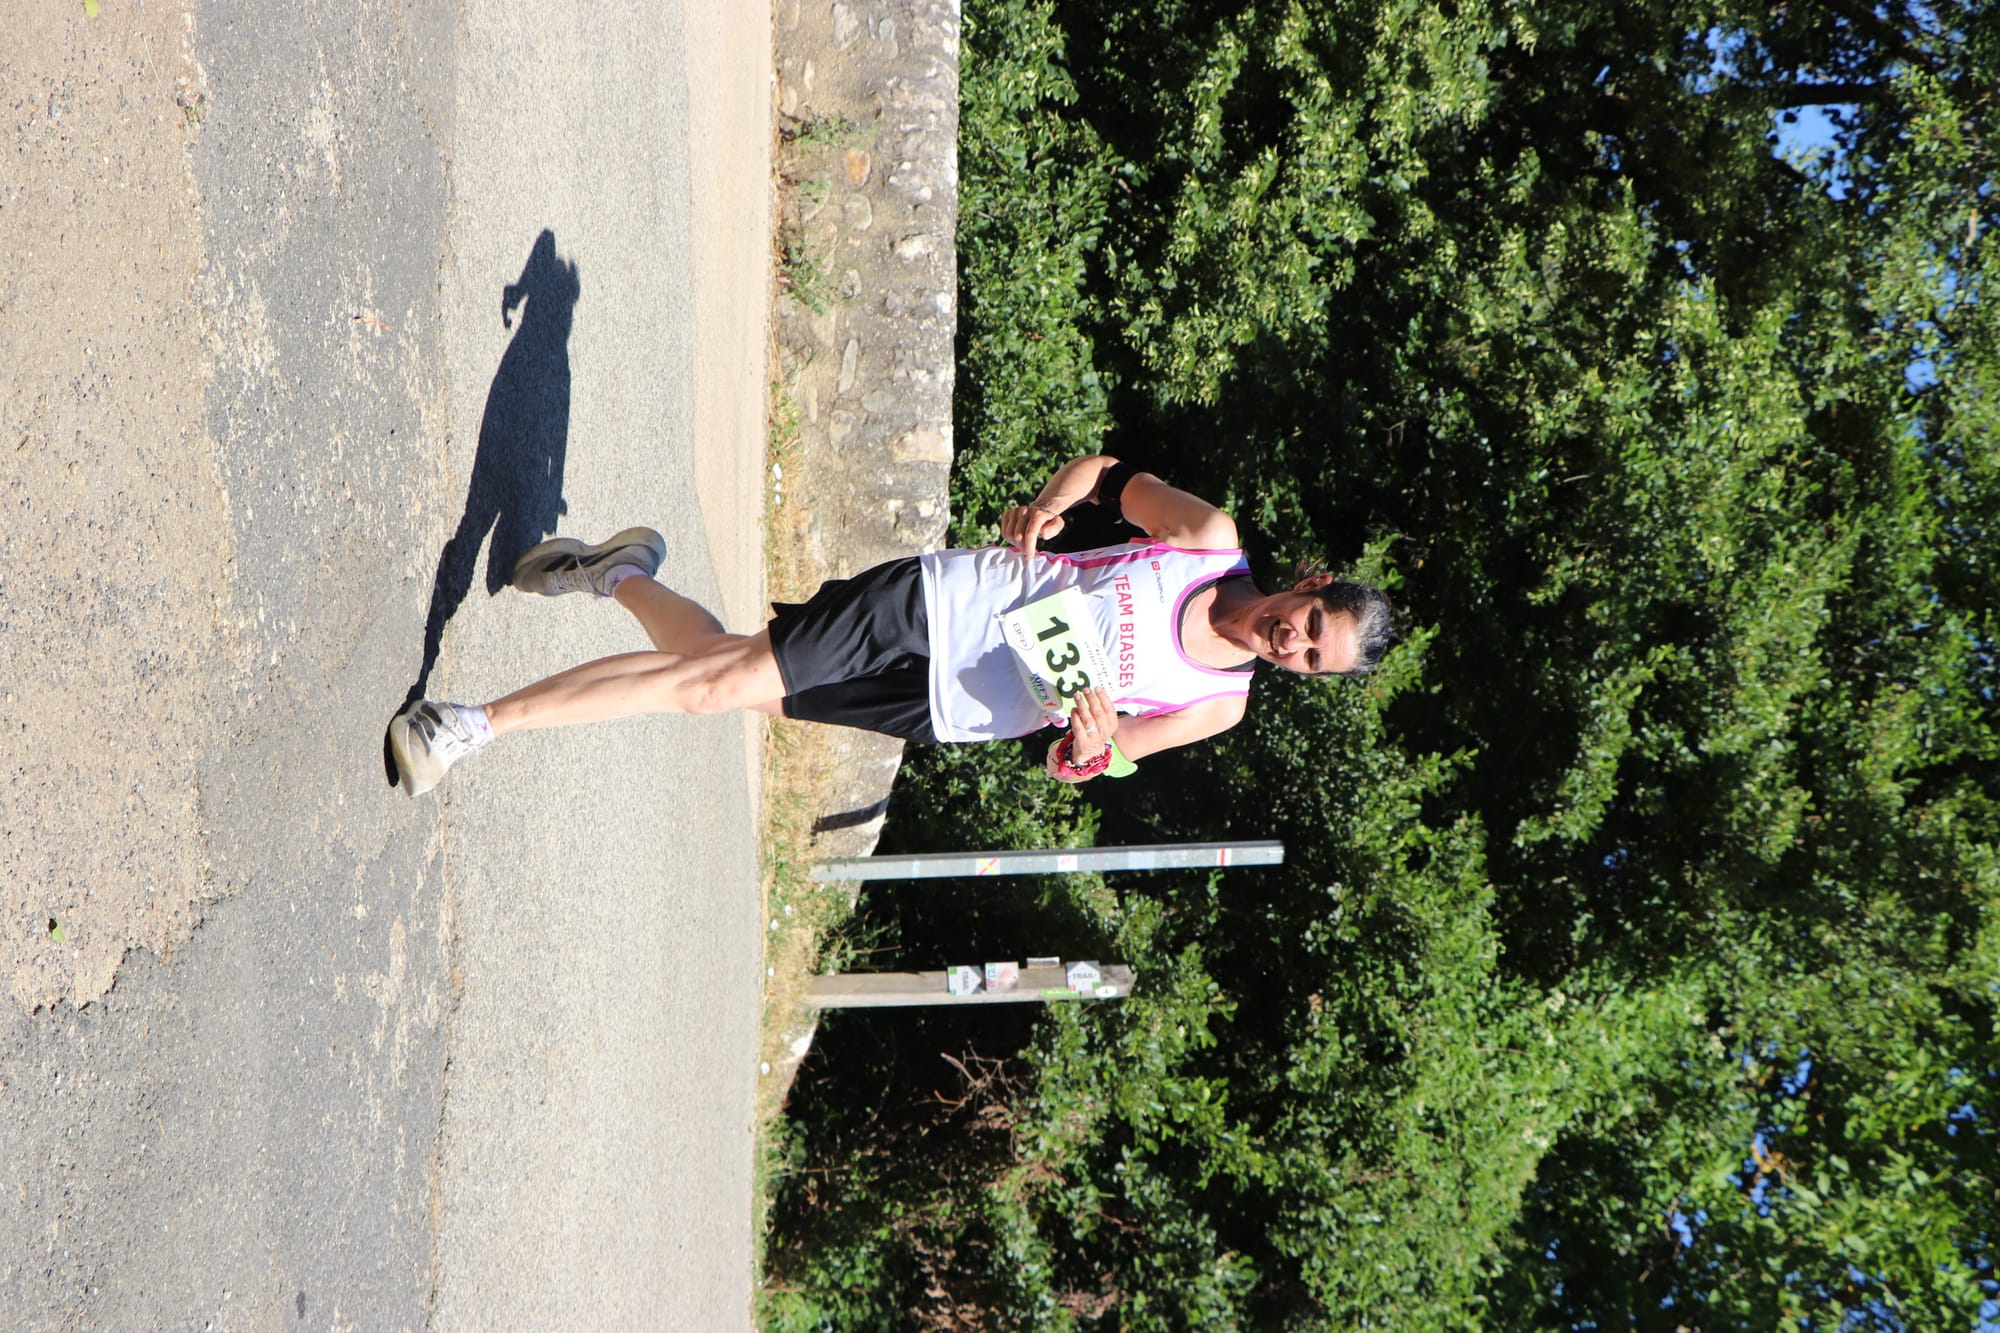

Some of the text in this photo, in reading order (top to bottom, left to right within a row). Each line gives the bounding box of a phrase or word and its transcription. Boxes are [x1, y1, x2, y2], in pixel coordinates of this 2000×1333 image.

[1036, 616, 1090, 699] 133
[1113, 574, 1134, 688] TEAM BIASSES
